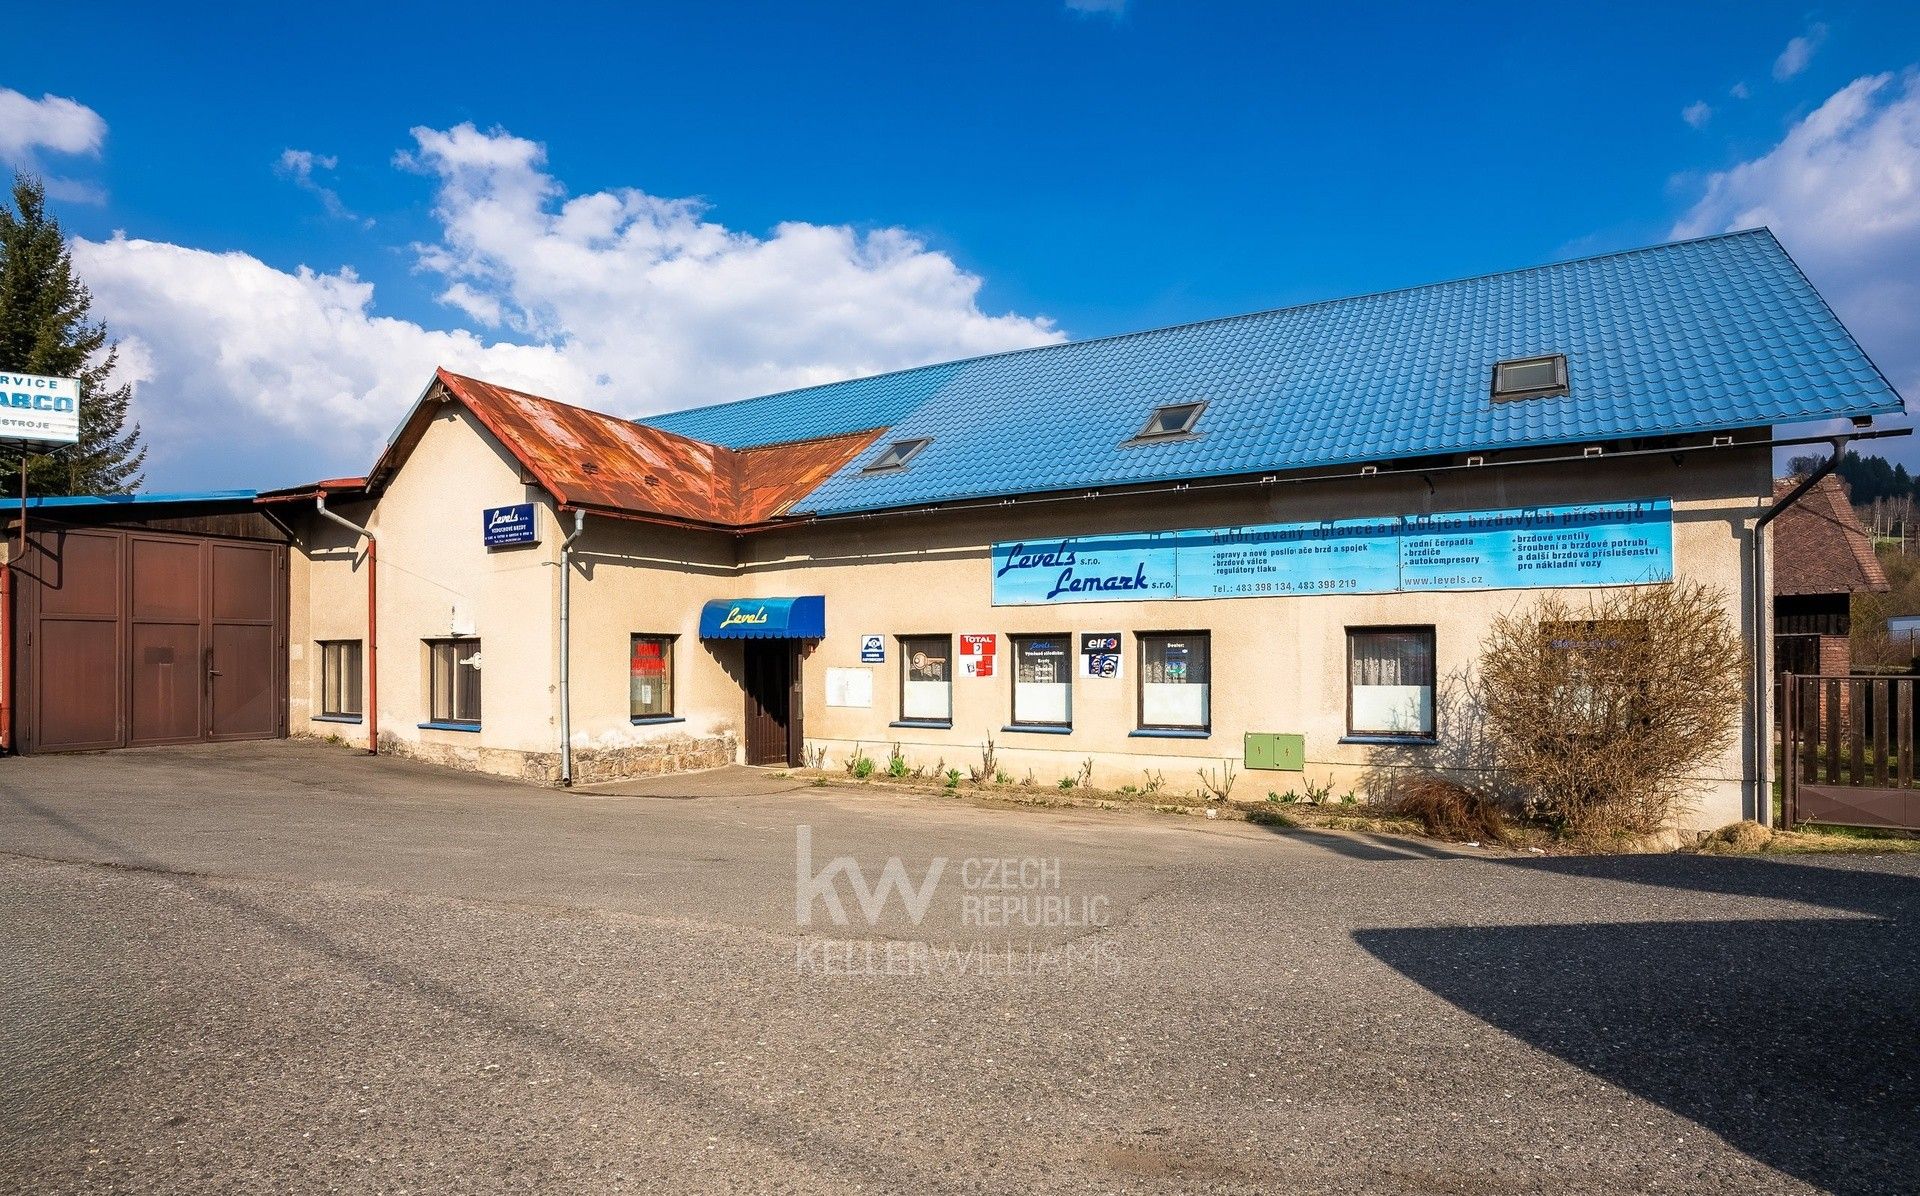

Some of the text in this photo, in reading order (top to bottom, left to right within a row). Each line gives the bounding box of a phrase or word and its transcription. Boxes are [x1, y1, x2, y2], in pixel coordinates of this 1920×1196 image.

[0, 375, 57, 389] RVICE
[488, 507, 519, 529] Levels
[1213, 526, 1305, 544] Autorizovaný
[1377, 523, 1386, 534] a
[1391, 516, 1462, 535] prodejce
[1468, 510, 1556, 528] brzdových
[1409, 537, 1474, 548] vodní čerpadla
[1517, 533, 1554, 543] brzdové
[1517, 542, 1559, 552] šroubení
[1570, 540, 1608, 550] brzdové
[1611, 537, 1649, 548] potrubí
[1216, 550, 1241, 560] opravy
[1249, 549, 1268, 558] nové
[1314, 545, 1332, 554] brzd
[1340, 543, 1368, 553] spojek
[1408, 548, 1441, 557] brzdiče
[1525, 551, 1550, 560] další
[1552, 550, 1590, 560] brzdová
[1592, 547, 1659, 558] příslušenství
[997, 540, 1101, 578] Levels s.r.o.
[1216, 557, 1268, 567] brzdové válce
[1409, 556, 1480, 566] autokompresory
[1517, 559, 1602, 571] pro nákladní vozy
[1216, 565, 1277, 575] regulátory tlaku
[1046, 562, 1174, 600] Lemark s.r.o.
[1213, 578, 1357, 593] Tel.: 483 398 134, 483 398 219
[1404, 575, 1483, 586] www.levels.cz
[719, 605, 768, 629] Levels
[963, 635, 993, 643] TOTAL
[1087, 638, 1107, 648] elf
